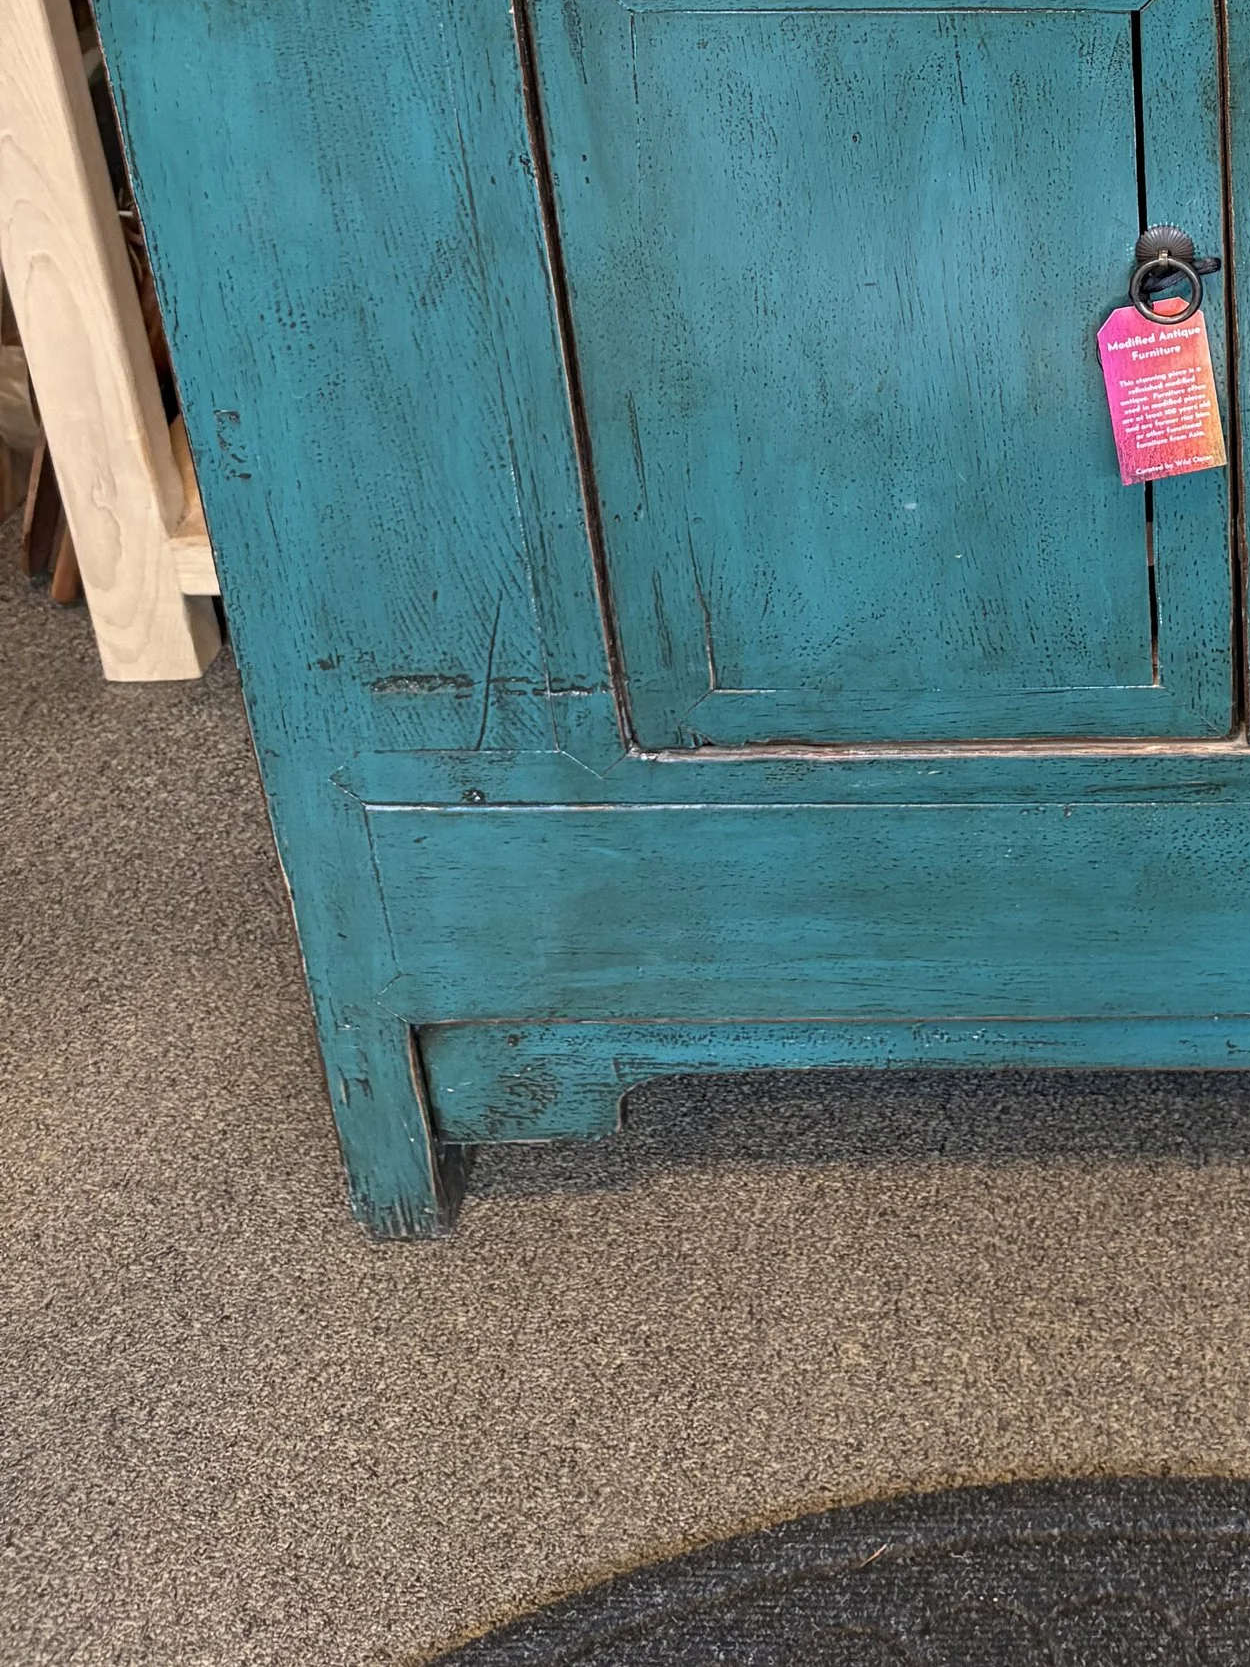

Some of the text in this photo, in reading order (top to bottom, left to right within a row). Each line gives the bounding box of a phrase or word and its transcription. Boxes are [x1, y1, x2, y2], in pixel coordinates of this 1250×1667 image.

[1107, 326, 1201, 352] Modified Antique
[1131, 345, 1181, 362] Furniture
[1119, 379, 1134, 388] This
[1136, 373, 1167, 386] stunning
[1152, 389, 1186, 399] Furniture
[1164, 461, 1175, 471] by
